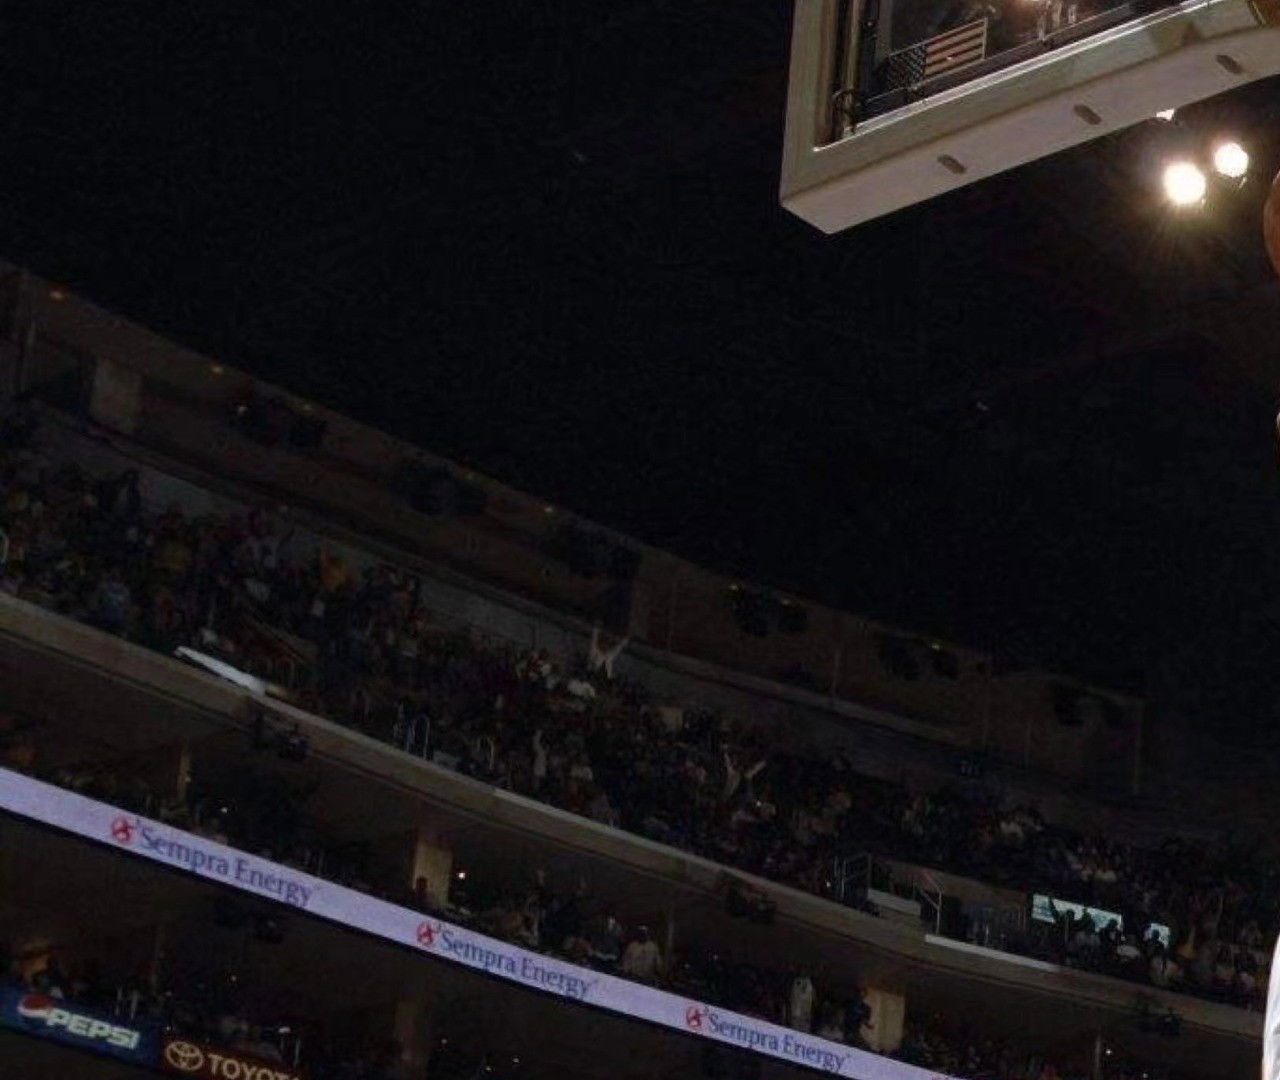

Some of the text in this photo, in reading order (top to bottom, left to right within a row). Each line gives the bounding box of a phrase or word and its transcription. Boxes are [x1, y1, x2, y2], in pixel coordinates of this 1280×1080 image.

[140, 824, 313, 908] Sempra Energy
[441, 926, 592, 1000] Sempra Energy
[47, 1007, 141, 1050] PEPSI
[707, 1011, 847, 1074] Sempra Energy
